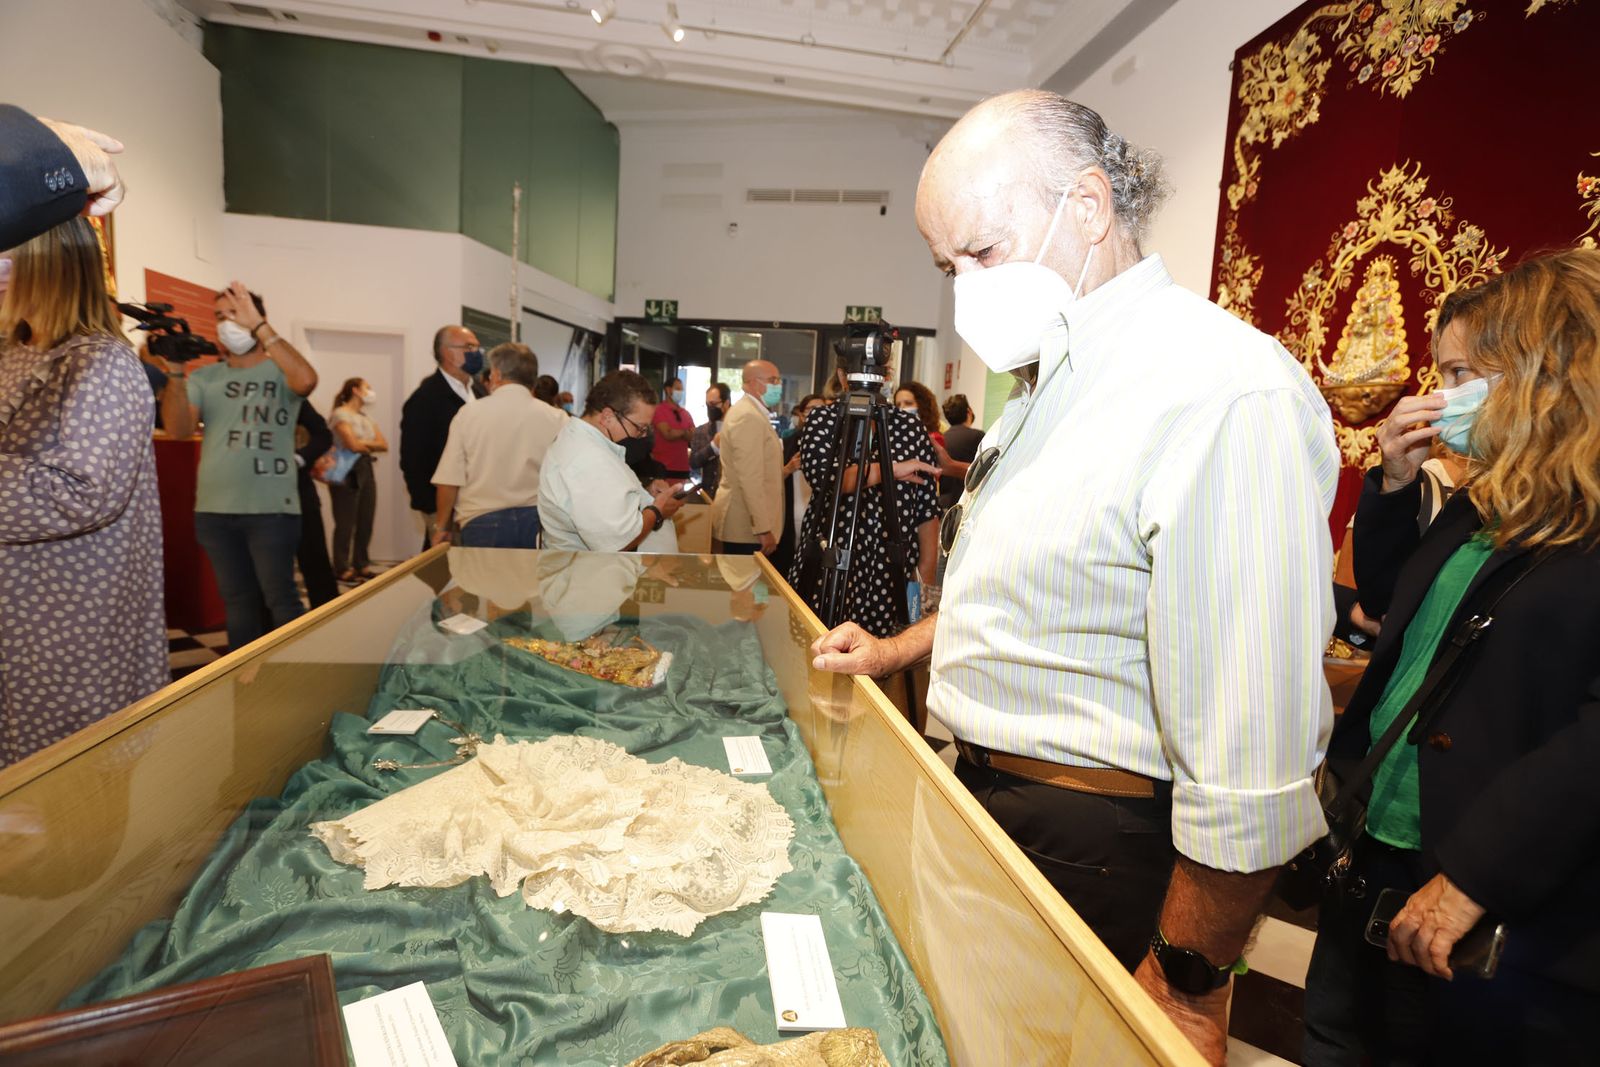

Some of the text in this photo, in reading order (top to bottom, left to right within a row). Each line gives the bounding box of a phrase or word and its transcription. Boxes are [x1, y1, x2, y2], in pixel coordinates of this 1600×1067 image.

[225, 381, 278, 399] SPR
[242, 405, 289, 426] ING
[227, 430, 274, 451] FIE
[254, 457, 289, 475] LD
